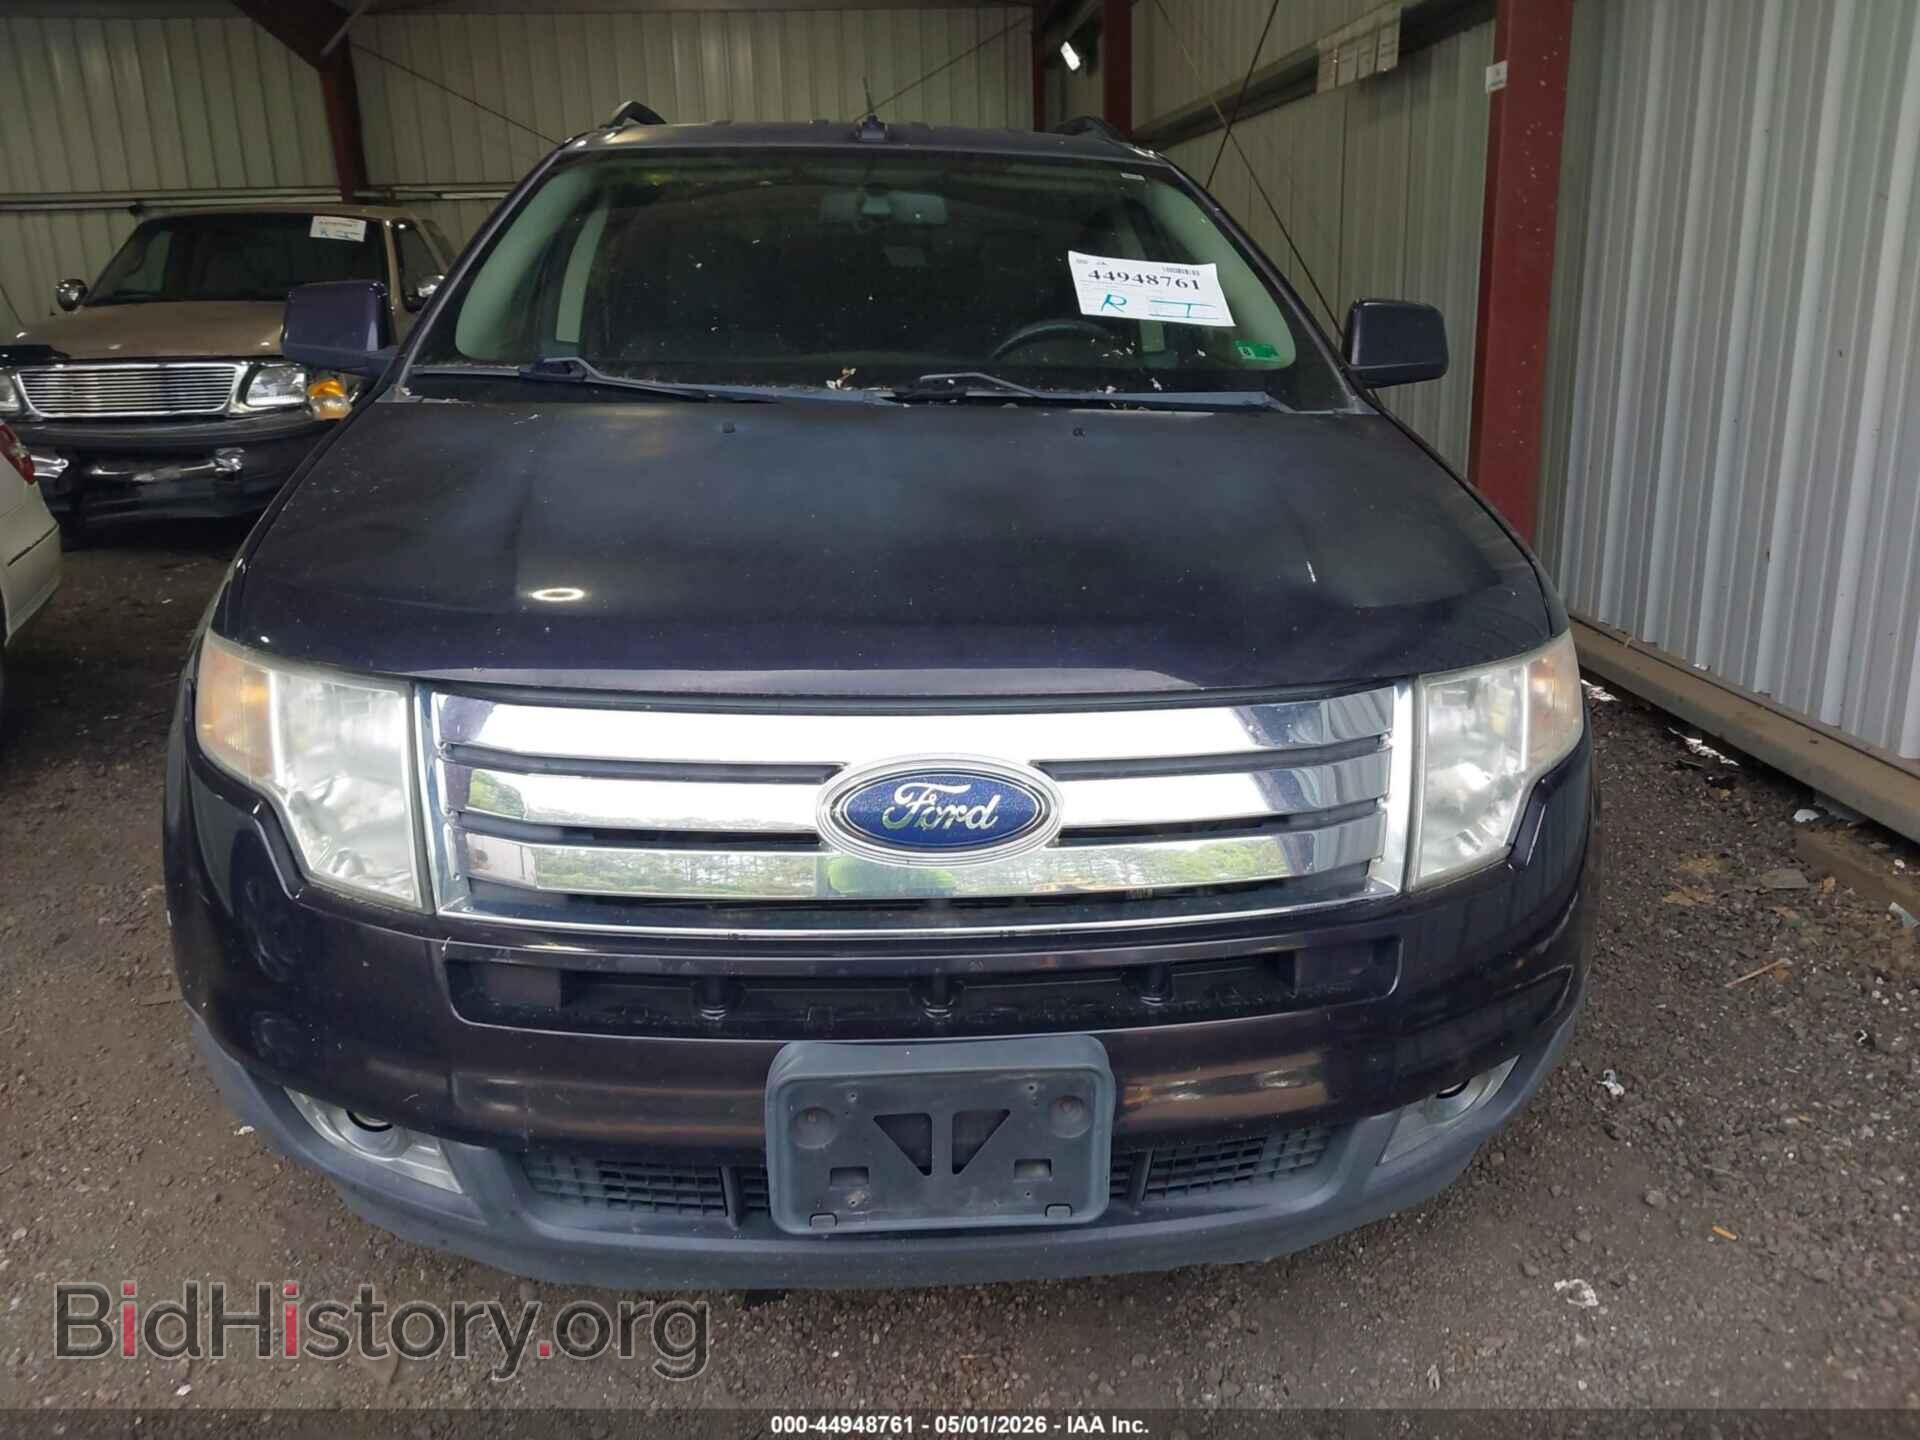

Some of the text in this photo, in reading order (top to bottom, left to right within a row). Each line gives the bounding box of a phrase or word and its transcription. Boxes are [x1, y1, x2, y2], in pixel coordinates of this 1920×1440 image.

[1088, 269, 1200, 290] 44948761
[1100, 293, 1128, 313] R
[881, 781, 1001, 830] Ford
